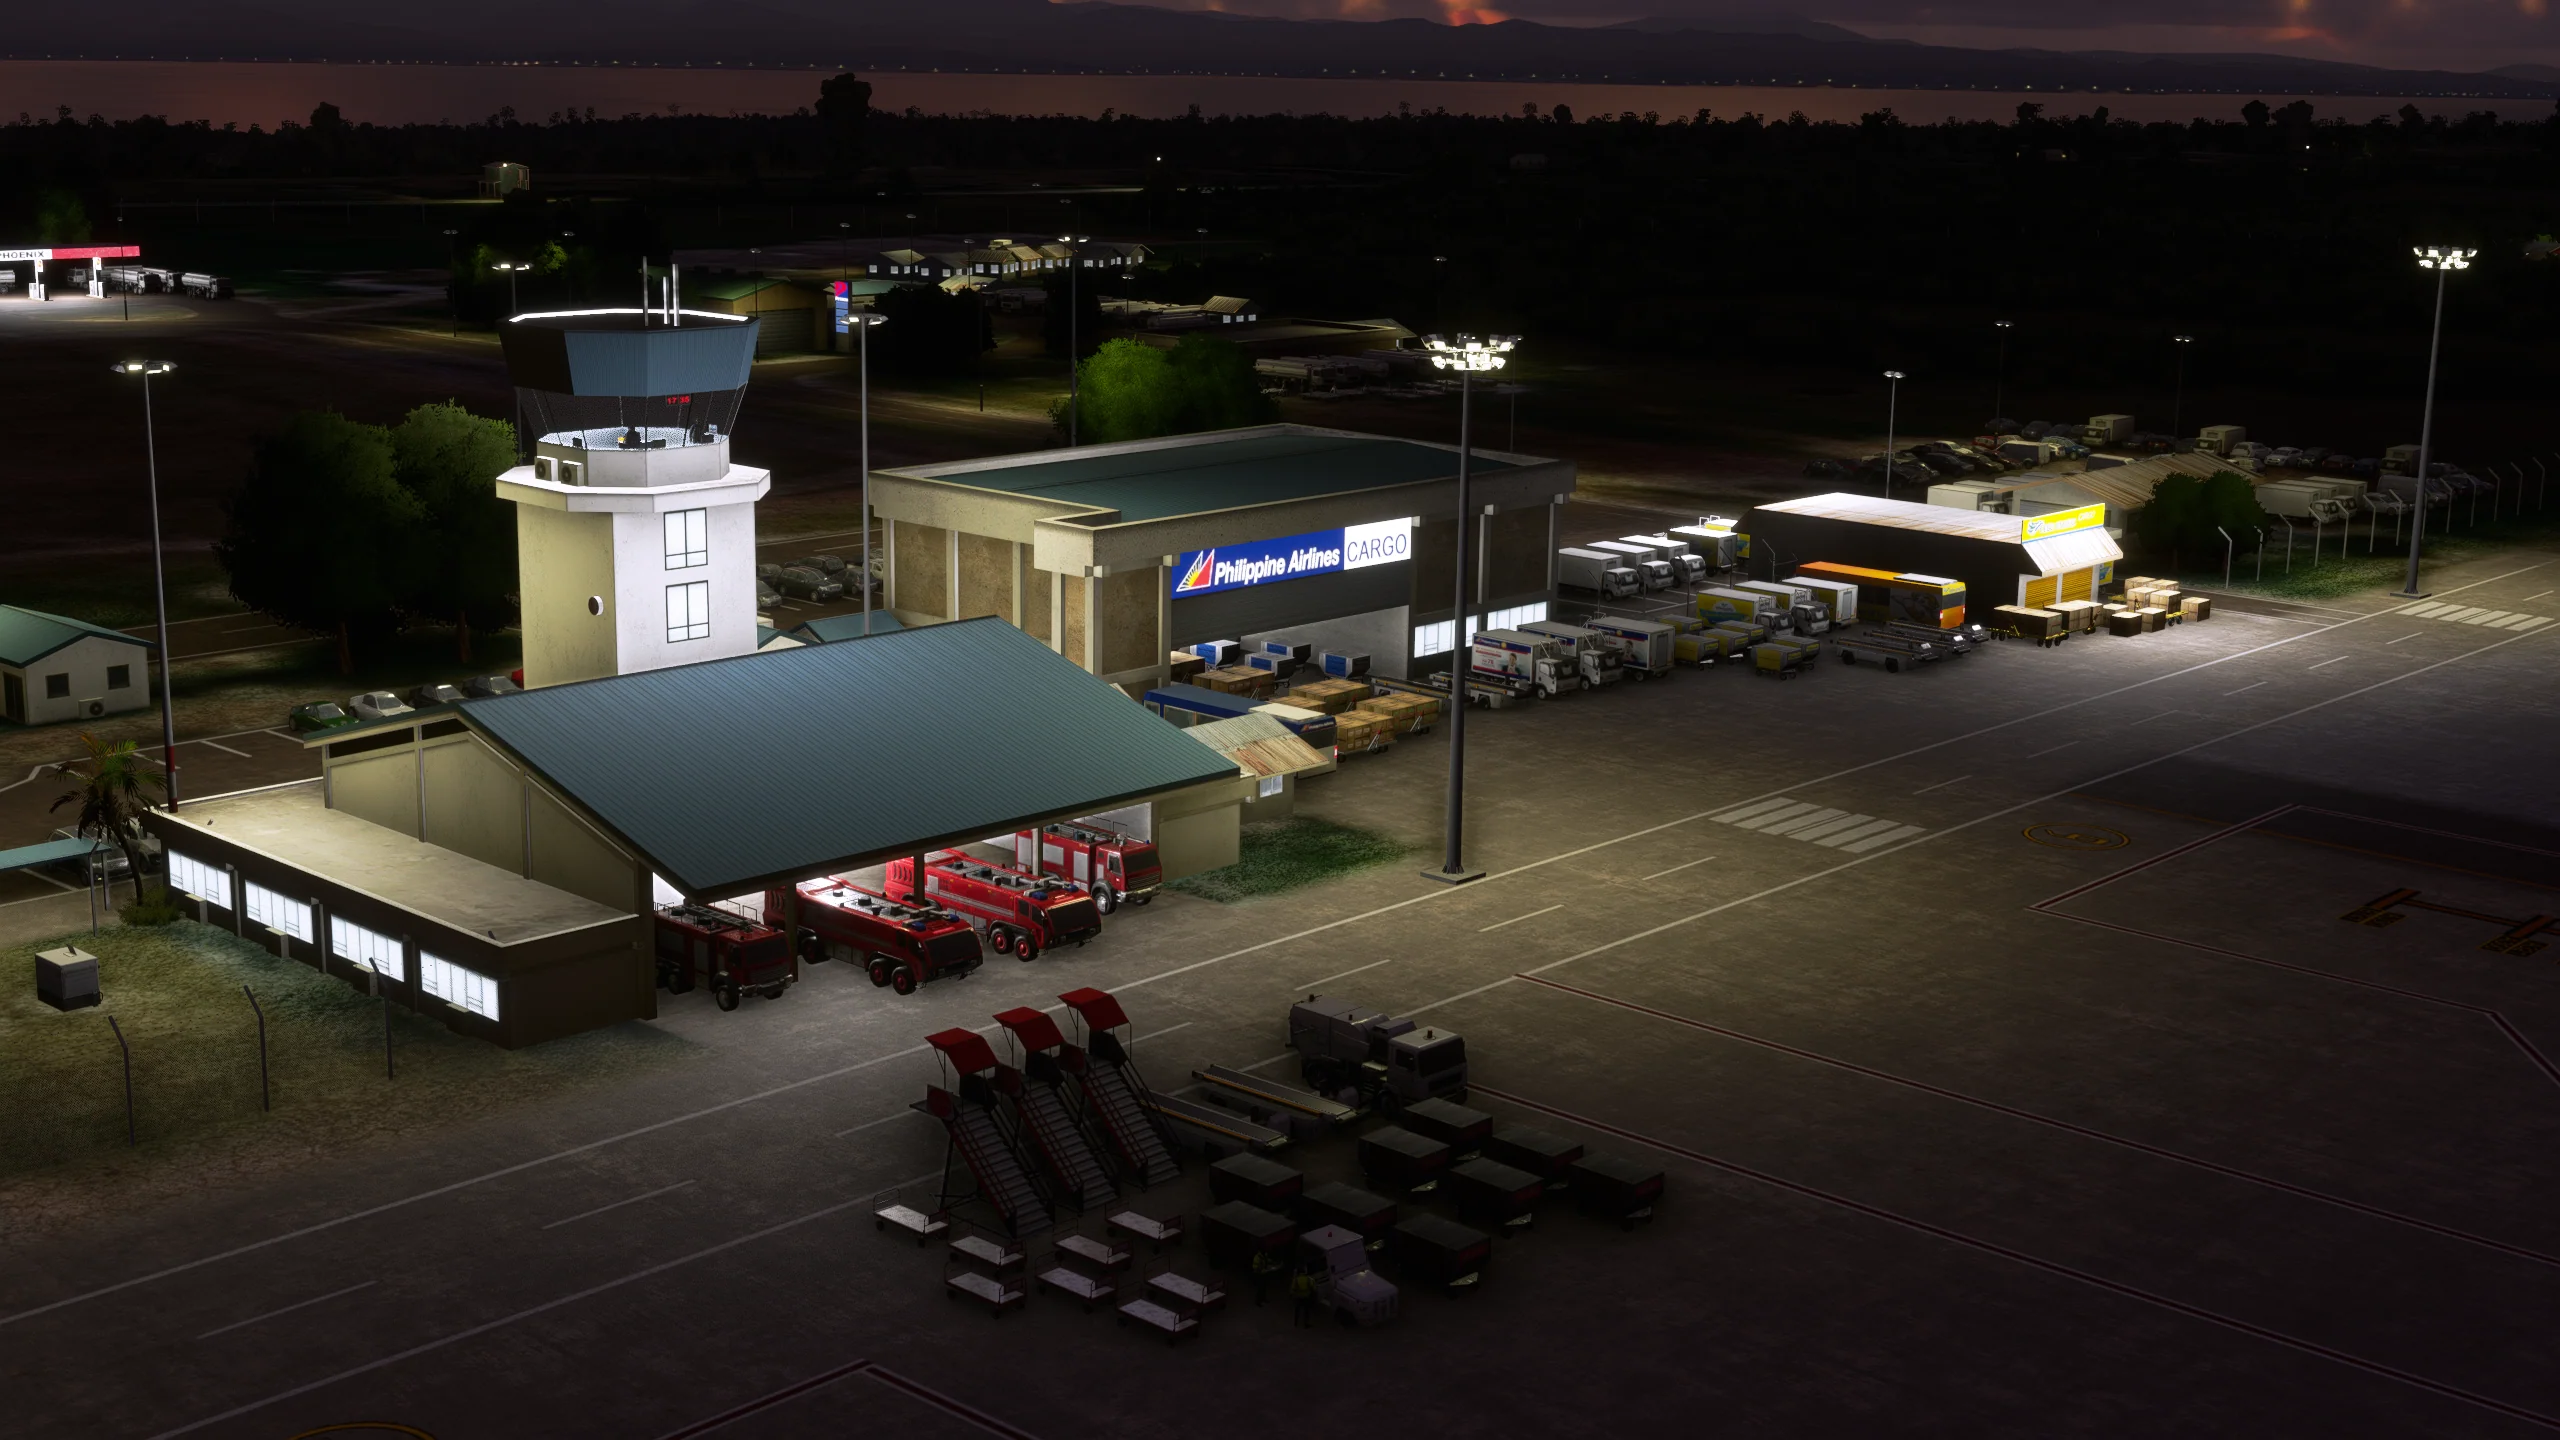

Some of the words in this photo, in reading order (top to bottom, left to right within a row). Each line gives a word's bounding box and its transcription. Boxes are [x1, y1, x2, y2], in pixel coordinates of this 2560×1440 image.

[0, 251, 44, 259] HOENIX
[1214, 554, 1286, 586] Philippine
[1287, 546, 1341, 574] Airlines
[1347, 533, 1407, 562] CARGO
